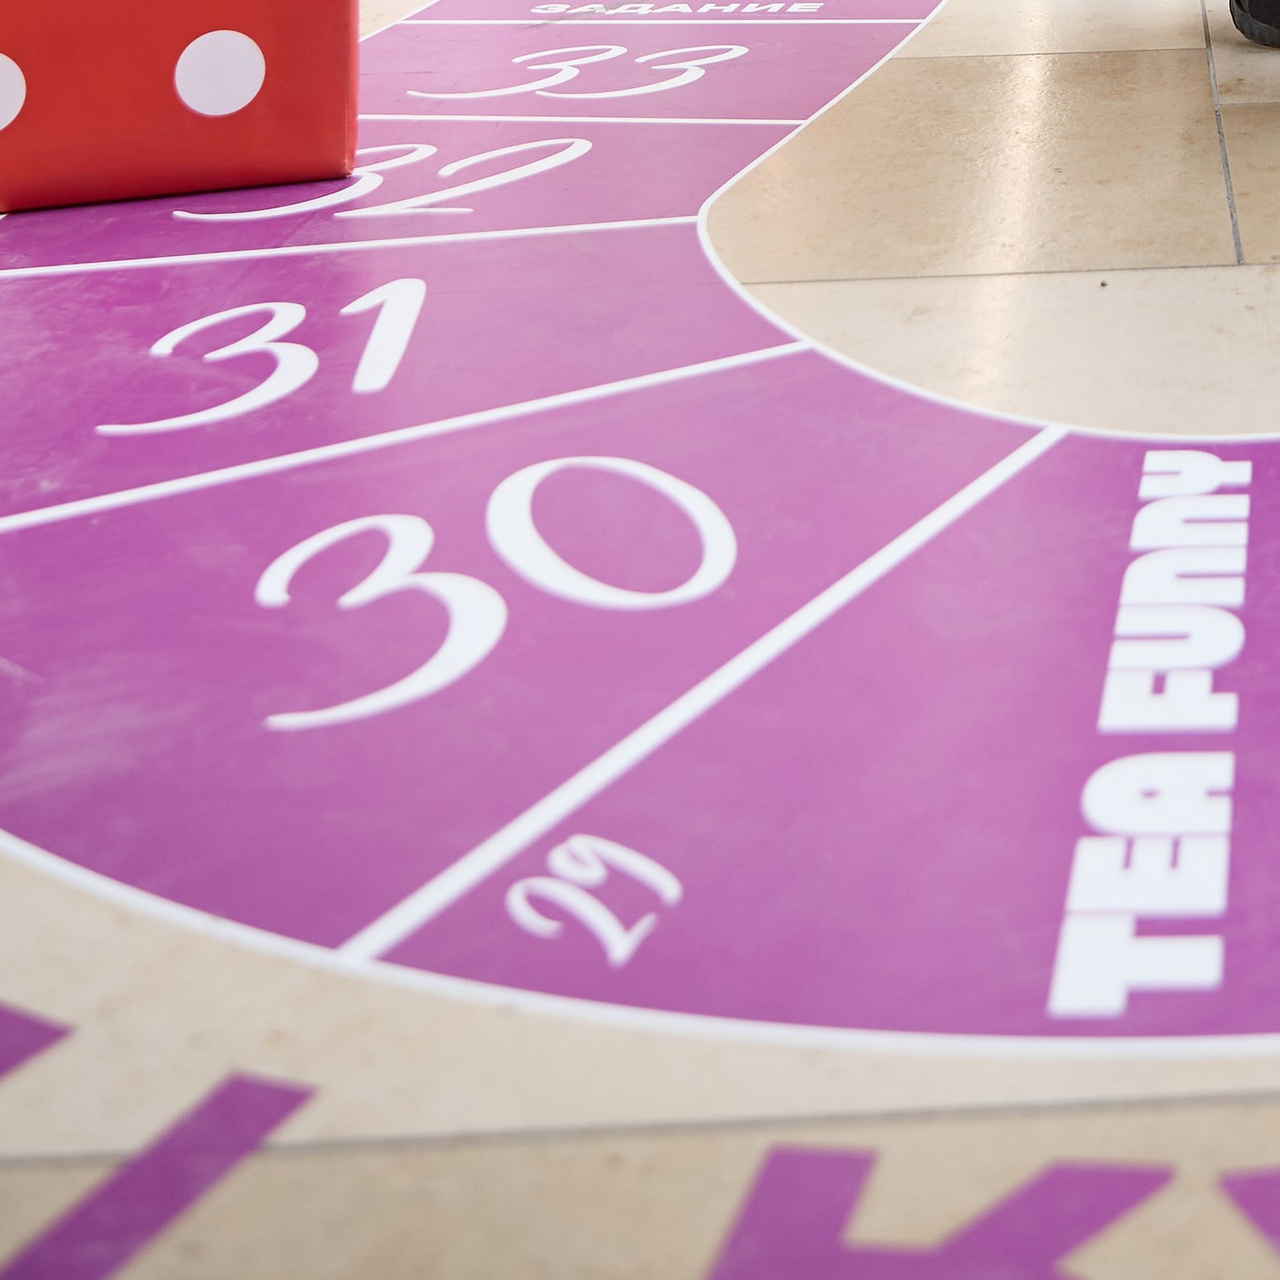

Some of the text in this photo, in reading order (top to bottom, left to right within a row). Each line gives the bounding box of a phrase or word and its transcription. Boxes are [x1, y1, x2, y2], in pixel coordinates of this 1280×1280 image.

[405, 43, 750, 100] 33
[529, 1, 826, 15] ЗАДАНИЕ
[94, 276, 427, 435] 31
[253, 453, 738, 731] 30
[1046, 447, 1253, 1019] TEA FUNNY
[503, 833, 684, 969] 29
